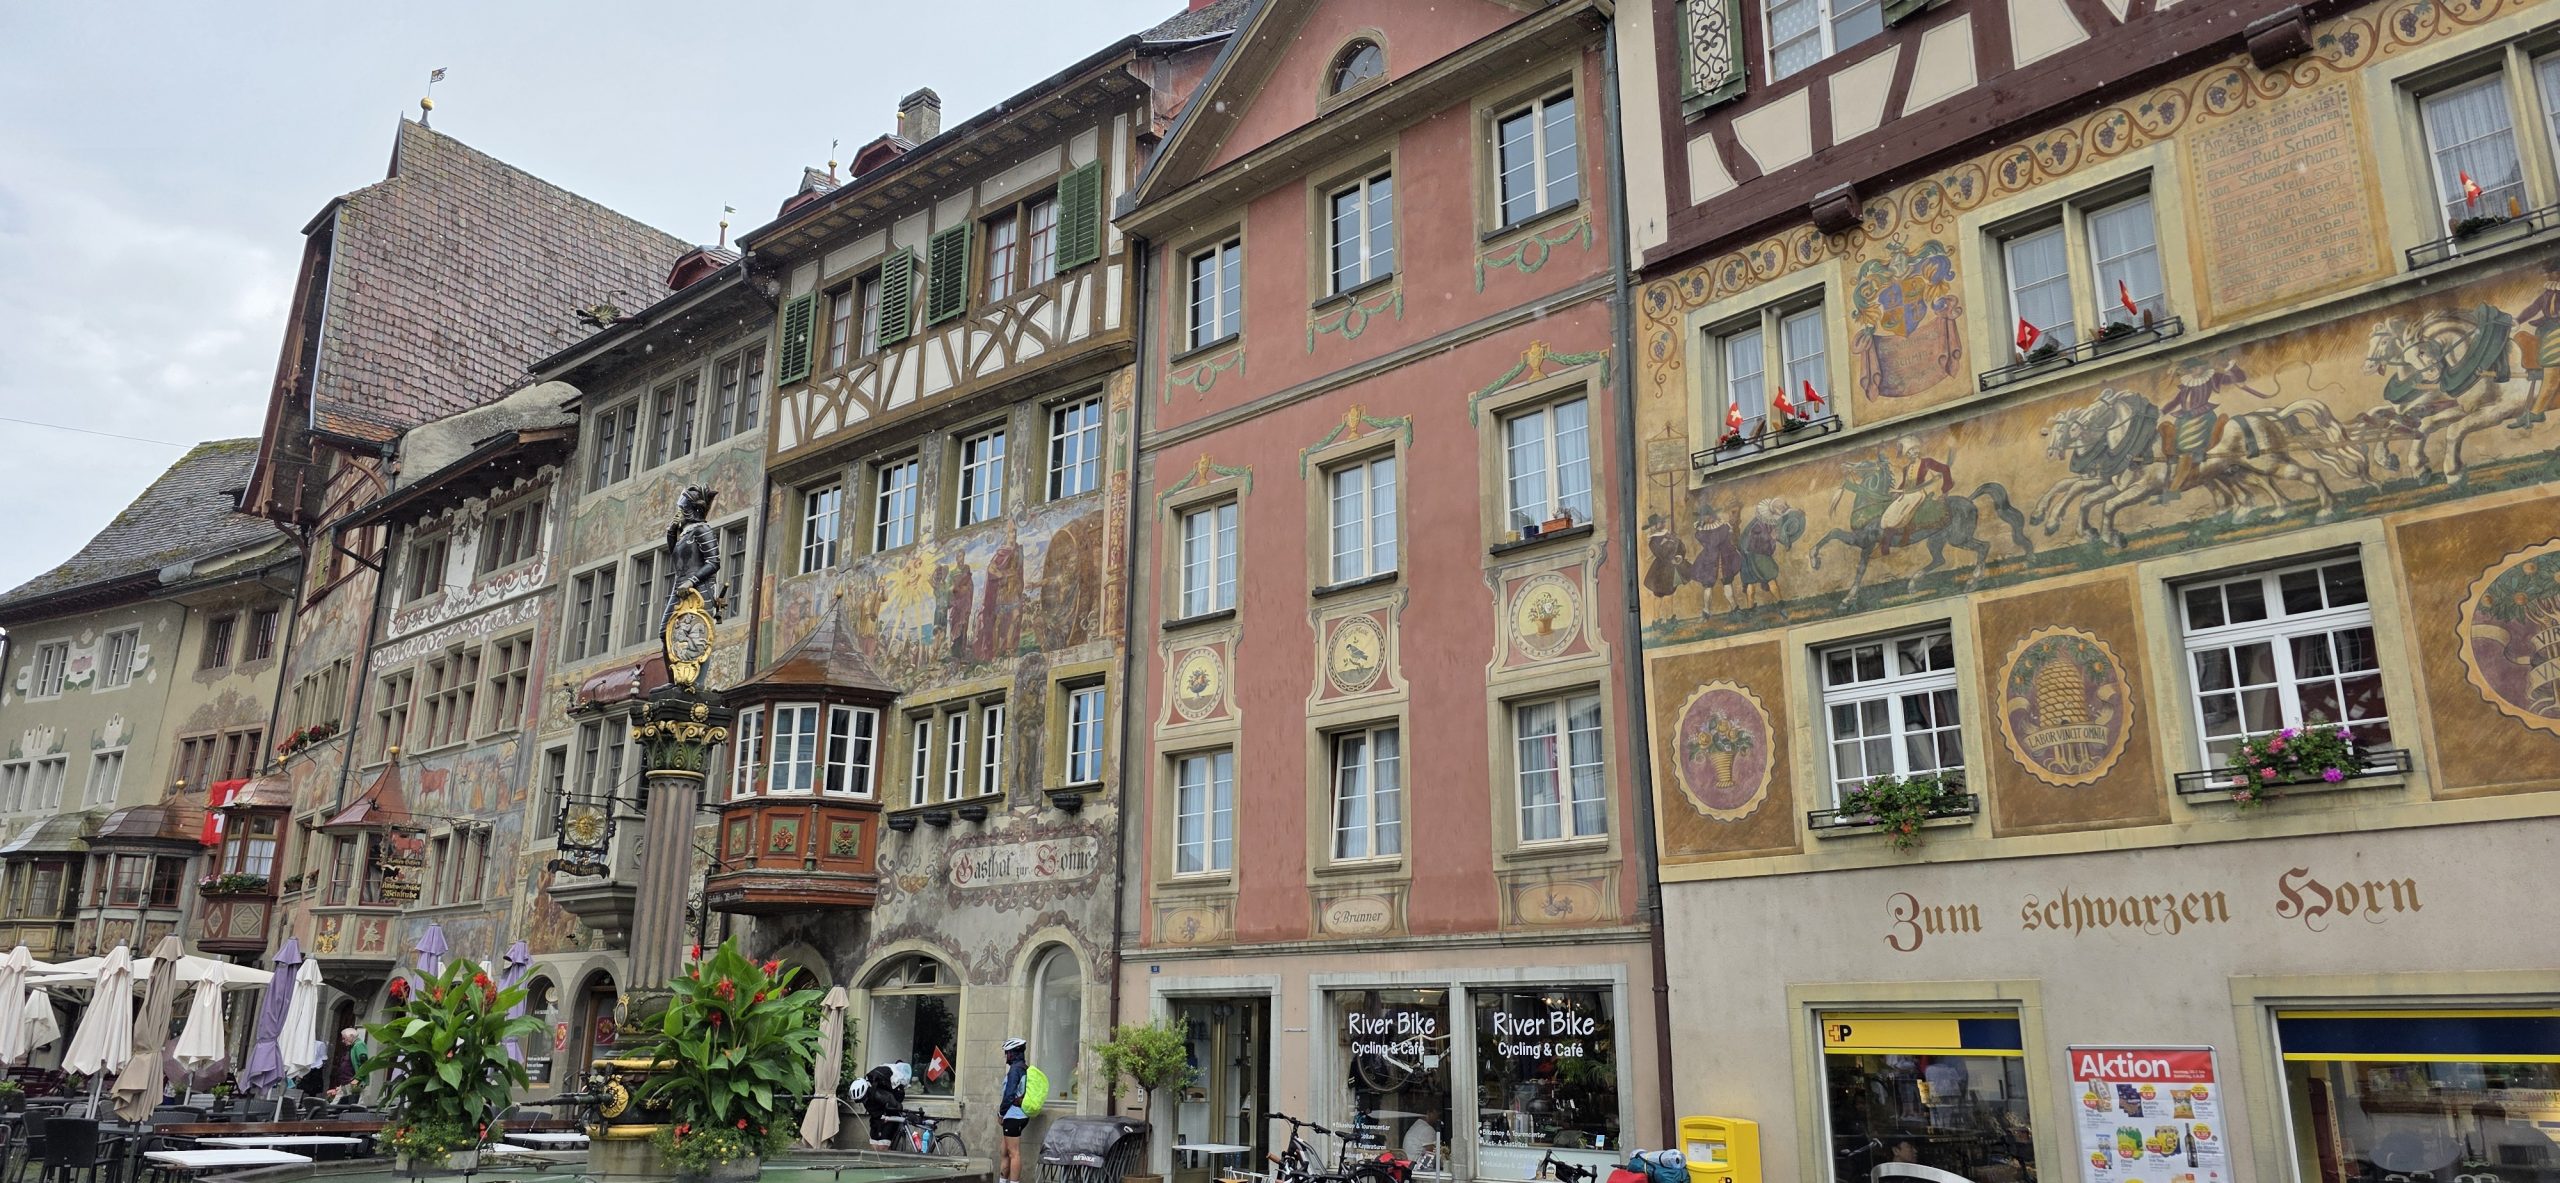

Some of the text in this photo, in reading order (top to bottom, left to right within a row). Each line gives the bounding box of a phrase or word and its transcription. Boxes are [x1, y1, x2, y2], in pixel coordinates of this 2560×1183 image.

[2202, 135, 2223, 150] Am
[2242, 113, 2291, 137] Februar
[2218, 143, 2236, 156] die
[2237, 133, 2269, 151] Stadt
[2272, 109, 2340, 139] eingefahren
[2284, 126, 2337, 154] Schmid
[2209, 184, 2230, 198] von
[2272, 175, 2306, 193] Stein
[2276, 192, 2296, 206] am
[2318, 198, 2354, 218] Sultan
[2265, 203, 2299, 222] Wien
[2314, 224, 2358, 246] seinem
[2028, 728, 2106, 748] LABOR VINCIT OMNIA
[956, 851, 1015, 884] Gasthof
[1883, 867, 2423, 952] Zum schwarzen Horn
[1350, 1011, 1436, 1035] River Bike
[1493, 1011, 1595, 1036] River Bike
[1352, 1041, 1425, 1057] Cycling & Café
[1498, 1041, 1584, 1059] Cycling & Café
[2079, 1052, 2171, 1078] Aktion
[1361, 1123, 1391, 1131] Tourencenter
[1483, 1129, 1505, 1137] Bikeshop
[1512, 1130, 1546, 1138] Tourencenter
